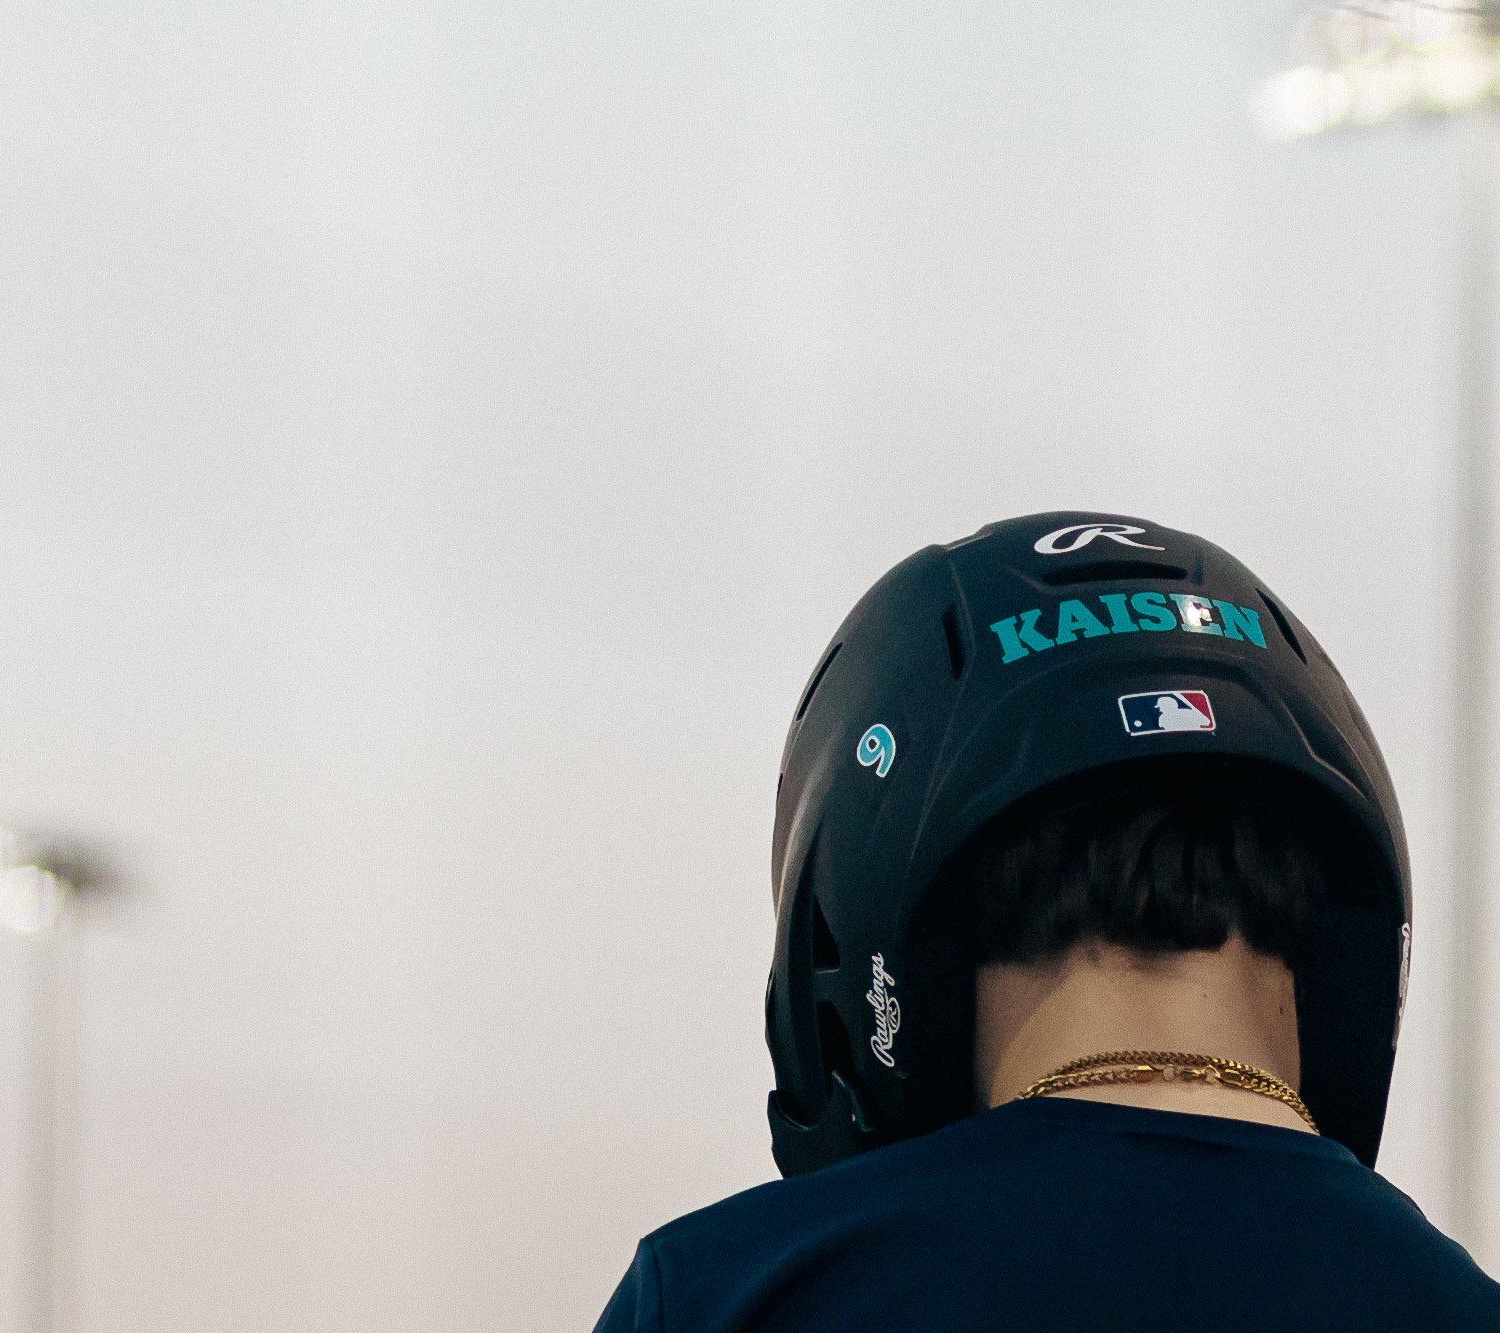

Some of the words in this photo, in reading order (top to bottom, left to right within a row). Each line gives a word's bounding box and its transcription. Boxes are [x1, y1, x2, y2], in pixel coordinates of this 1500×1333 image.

[989, 591, 1267, 664] KAISEN
[856, 723, 897, 779] 9
[866, 952, 897, 1068] Rawlings
